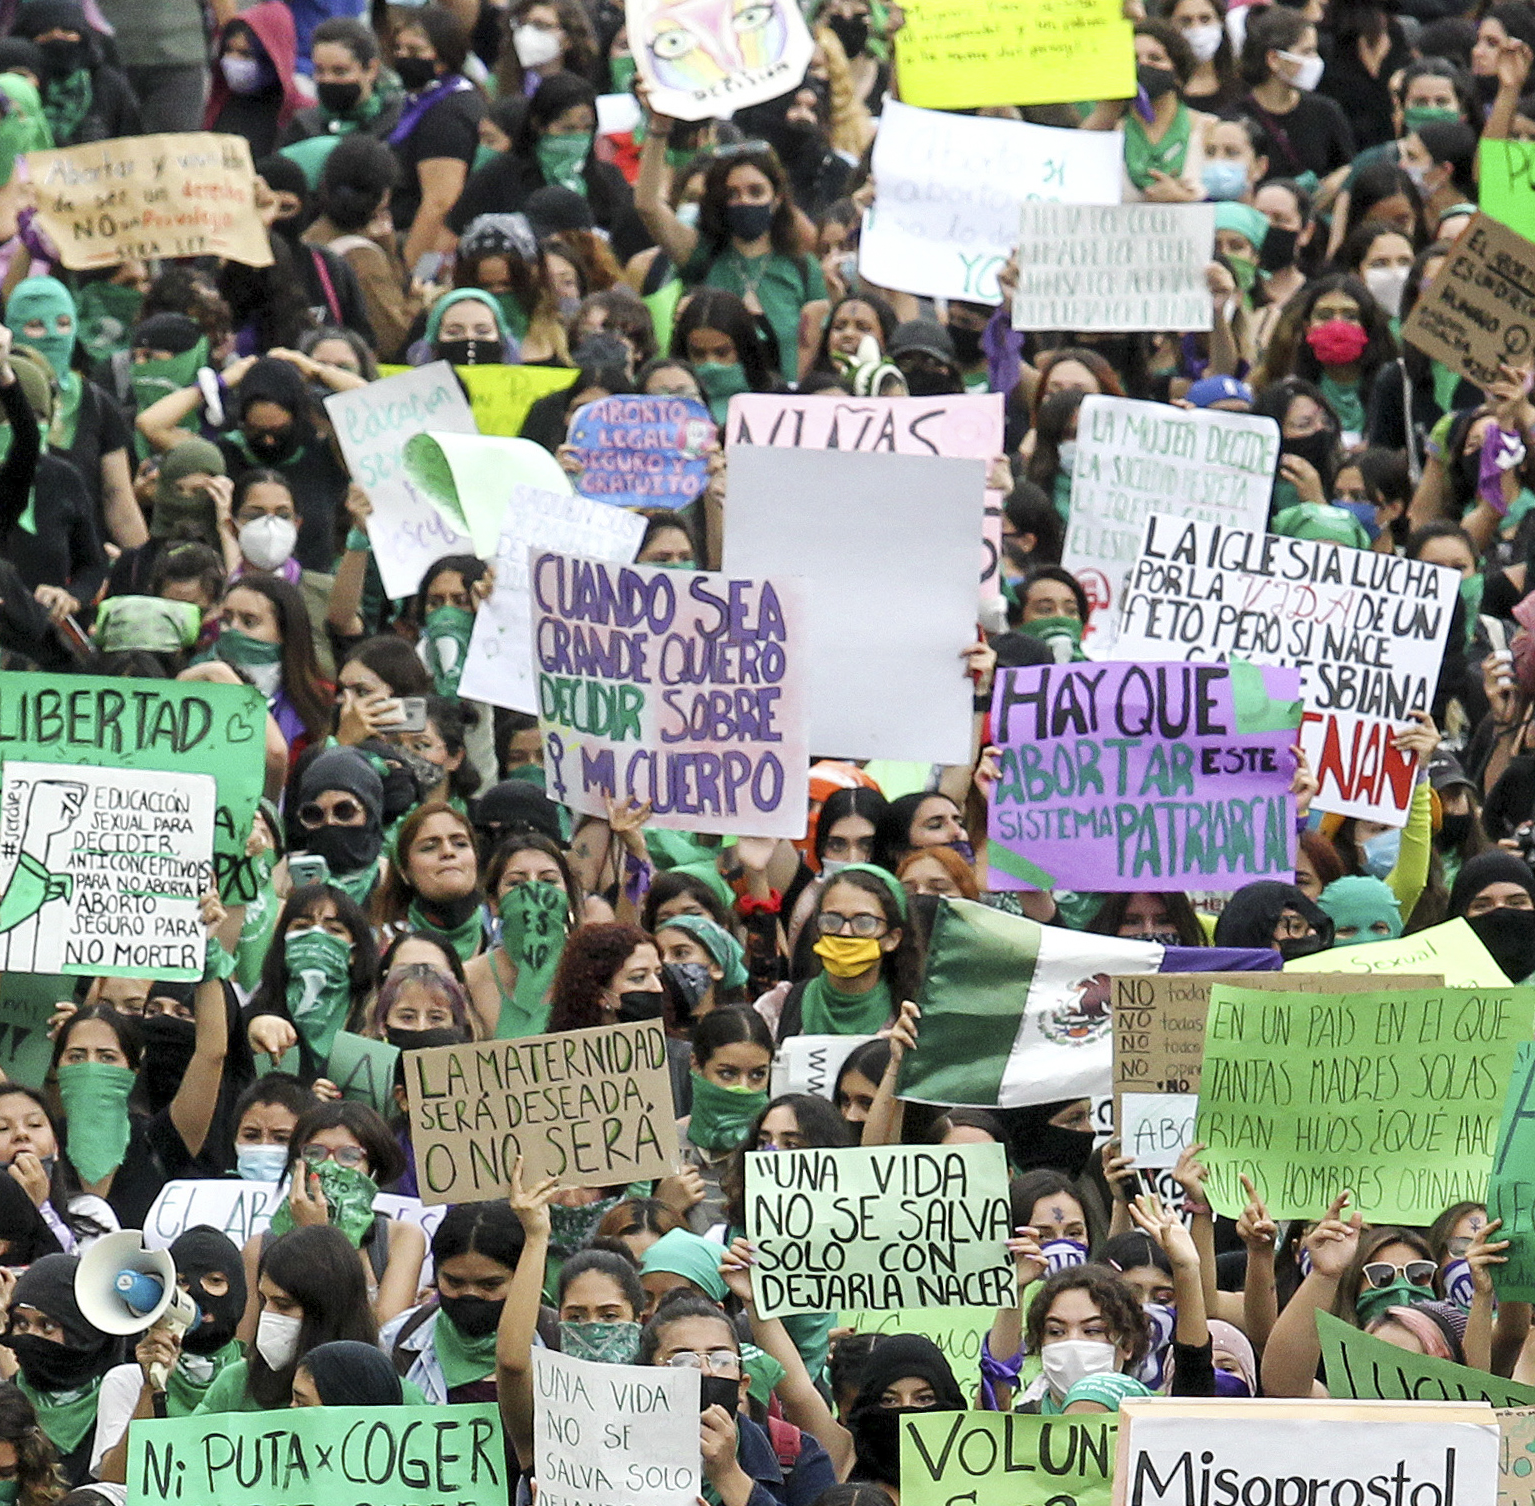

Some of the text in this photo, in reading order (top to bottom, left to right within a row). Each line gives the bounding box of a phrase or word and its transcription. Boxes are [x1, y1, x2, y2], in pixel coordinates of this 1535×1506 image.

[1145, 515, 1197, 567] LA
[1208, 530, 1343, 586] IGLESIA
[1352, 549, 1440, 600] LUCHA
[534, 553, 787, 642] CUANDO SEA
[537, 617, 786, 685] GRANDE QUIERO
[999, 666, 1231, 743] HAY QUE
[994, 738, 1279, 808] ABORTAR ESTE
[94, 787, 189, 813] EDUCACIÓN
[70, 915, 201, 938] SEGURO PARA
[75, 894, 157, 914] ABORTO
[67, 940, 197, 969] NO MORIR
[1118, 980, 1155, 1007] NO
[1212, 1001, 1244, 1041] EN
[1261, 1003, 1291, 1046] UN
[1306, 995, 1355, 1048] PAÍS
[1375, 1002, 1407, 1045] EN
[1454, 997, 1513, 1042] QUE
[417, 1026, 666, 1099] LA MATERNIDAD
[1120, 1059, 1149, 1077] NO
[1204, 1054, 1497, 1106] TANTAS MADRES SOLAS
[426, 1102, 664, 1193] O NO SERÁ
[756, 1193, 1013, 1244] NO SE SALVA
[758, 1240, 957, 1274] SOLO CON
[537, 1360, 672, 1413] UNA VIDA
[546, 1416, 631, 1452] NO SE
[545, 1452, 694, 1493] SALVA SOLO
